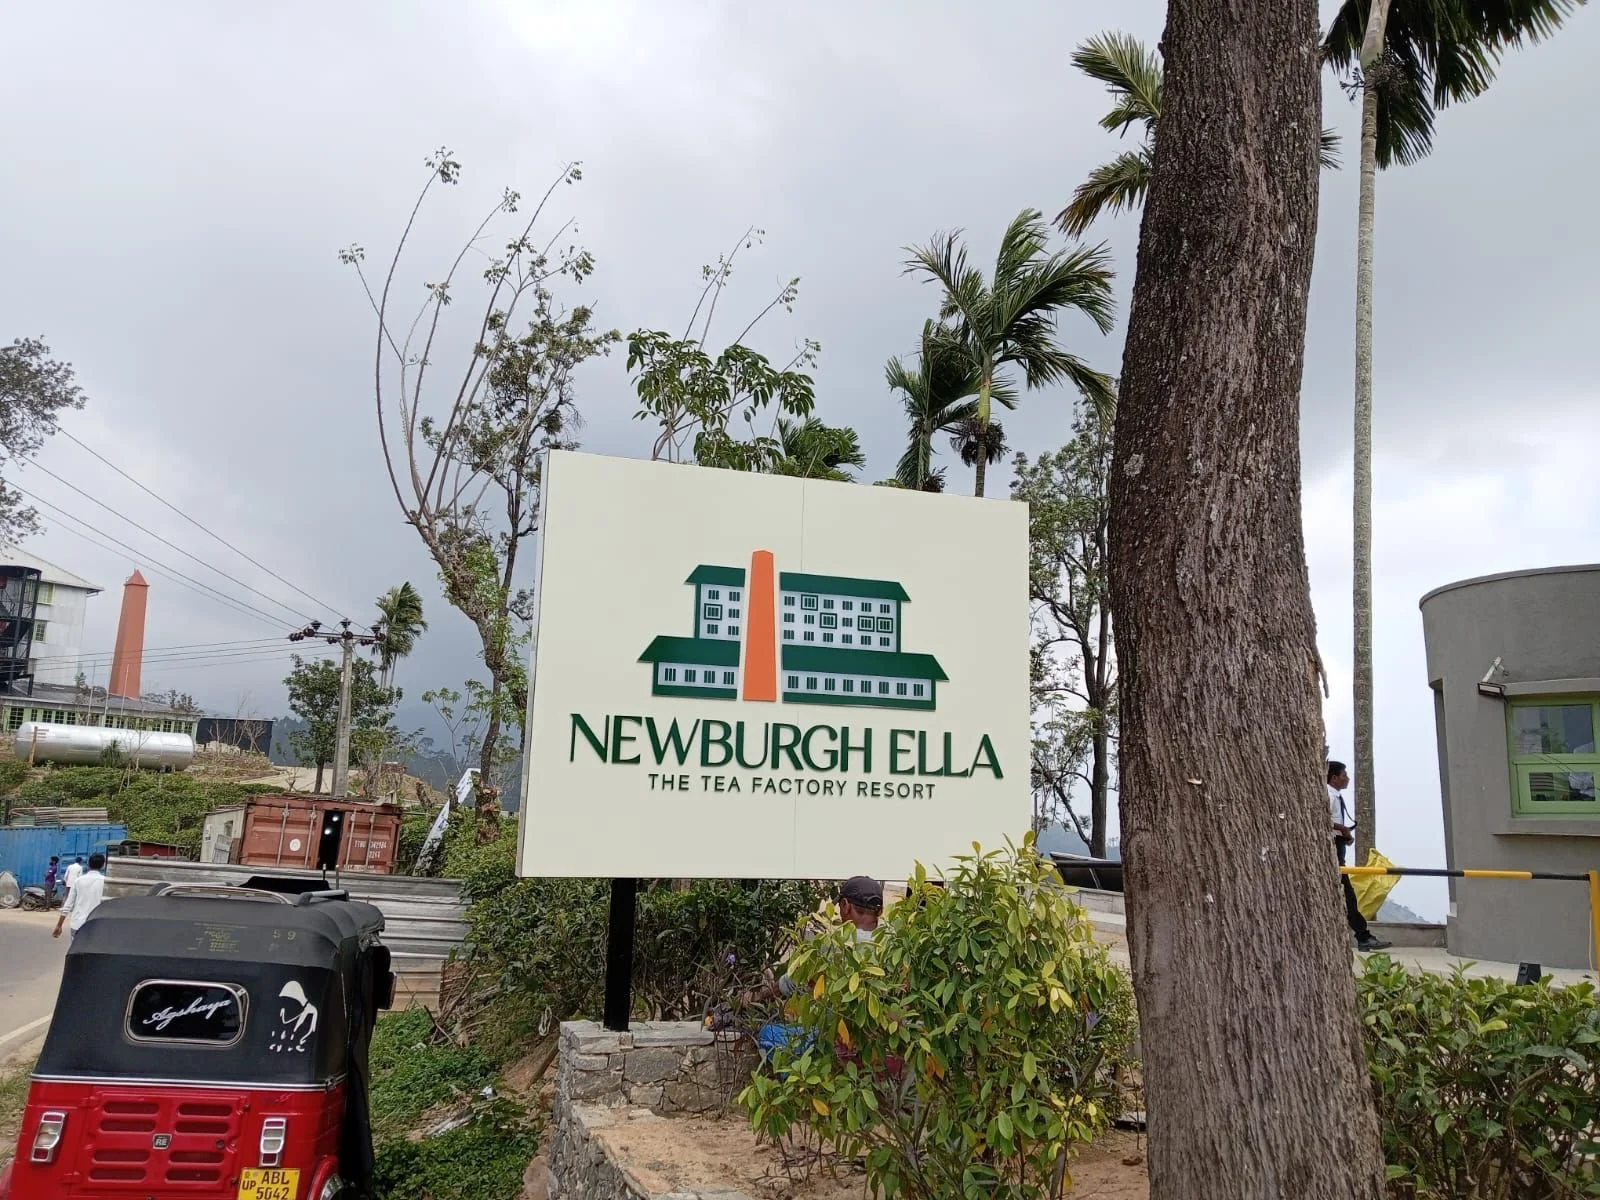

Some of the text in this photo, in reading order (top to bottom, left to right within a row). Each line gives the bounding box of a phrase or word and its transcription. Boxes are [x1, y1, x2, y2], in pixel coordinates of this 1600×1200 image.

[570, 713, 1004, 780] NEWBURGH ELLA
[648, 774, 936, 799] THE TEA FACTORY RESORT
[155, 1138, 168, 1147] RE
[261, 1171, 290, 1185] ABL
[241, 1180, 256, 1190] UP
[255, 1187, 290, 1200] 5042
